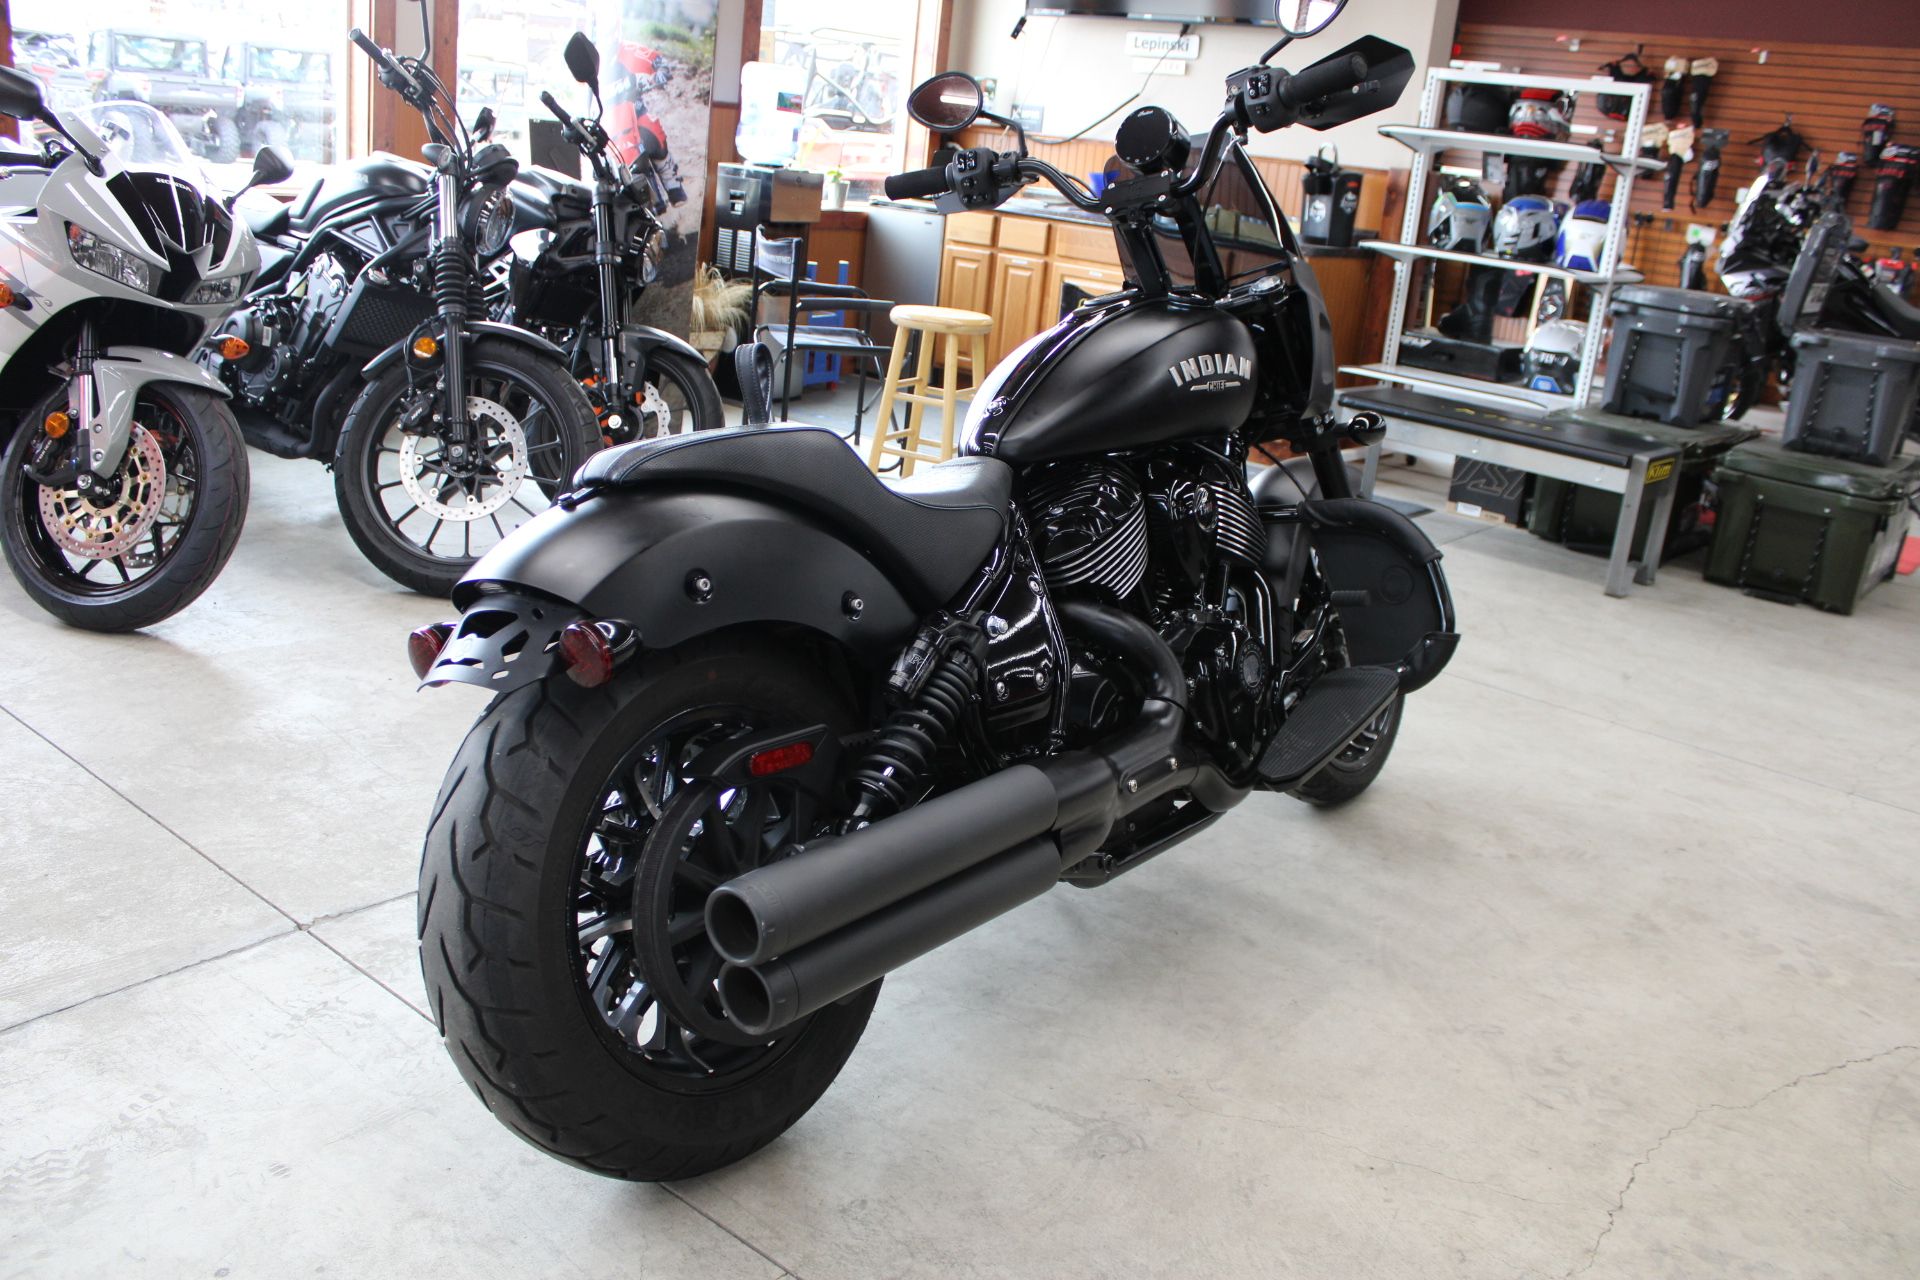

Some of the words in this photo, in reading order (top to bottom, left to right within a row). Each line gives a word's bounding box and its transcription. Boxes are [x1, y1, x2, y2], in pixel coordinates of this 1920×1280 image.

[1134, 36, 1189, 52] Lepinski
[155, 177, 192, 193] HONDA
[1168, 353, 1252, 388] INDIAN
[1207, 380, 1225, 392] CHIEF
